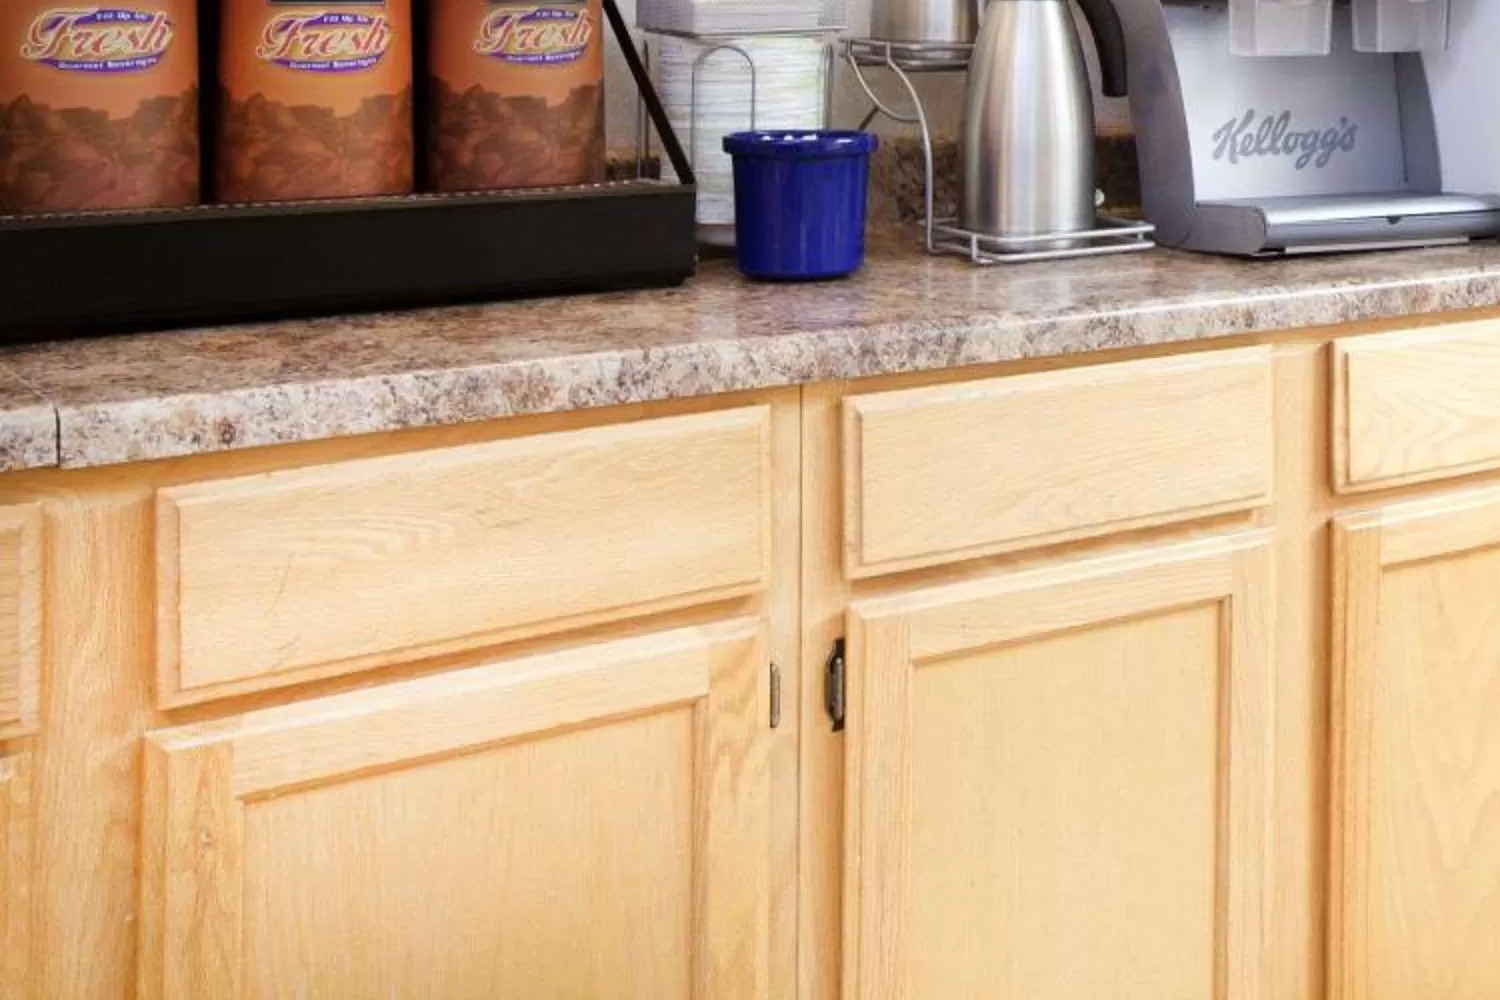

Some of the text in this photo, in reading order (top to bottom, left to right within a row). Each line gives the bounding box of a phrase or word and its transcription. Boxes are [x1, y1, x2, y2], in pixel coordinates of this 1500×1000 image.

[20, 7, 171, 60] Fresh
[257, 12, 391, 60] Fresh
[474, 8, 592, 53] Fresh
[1212, 108, 1359, 171] Kellogg's
